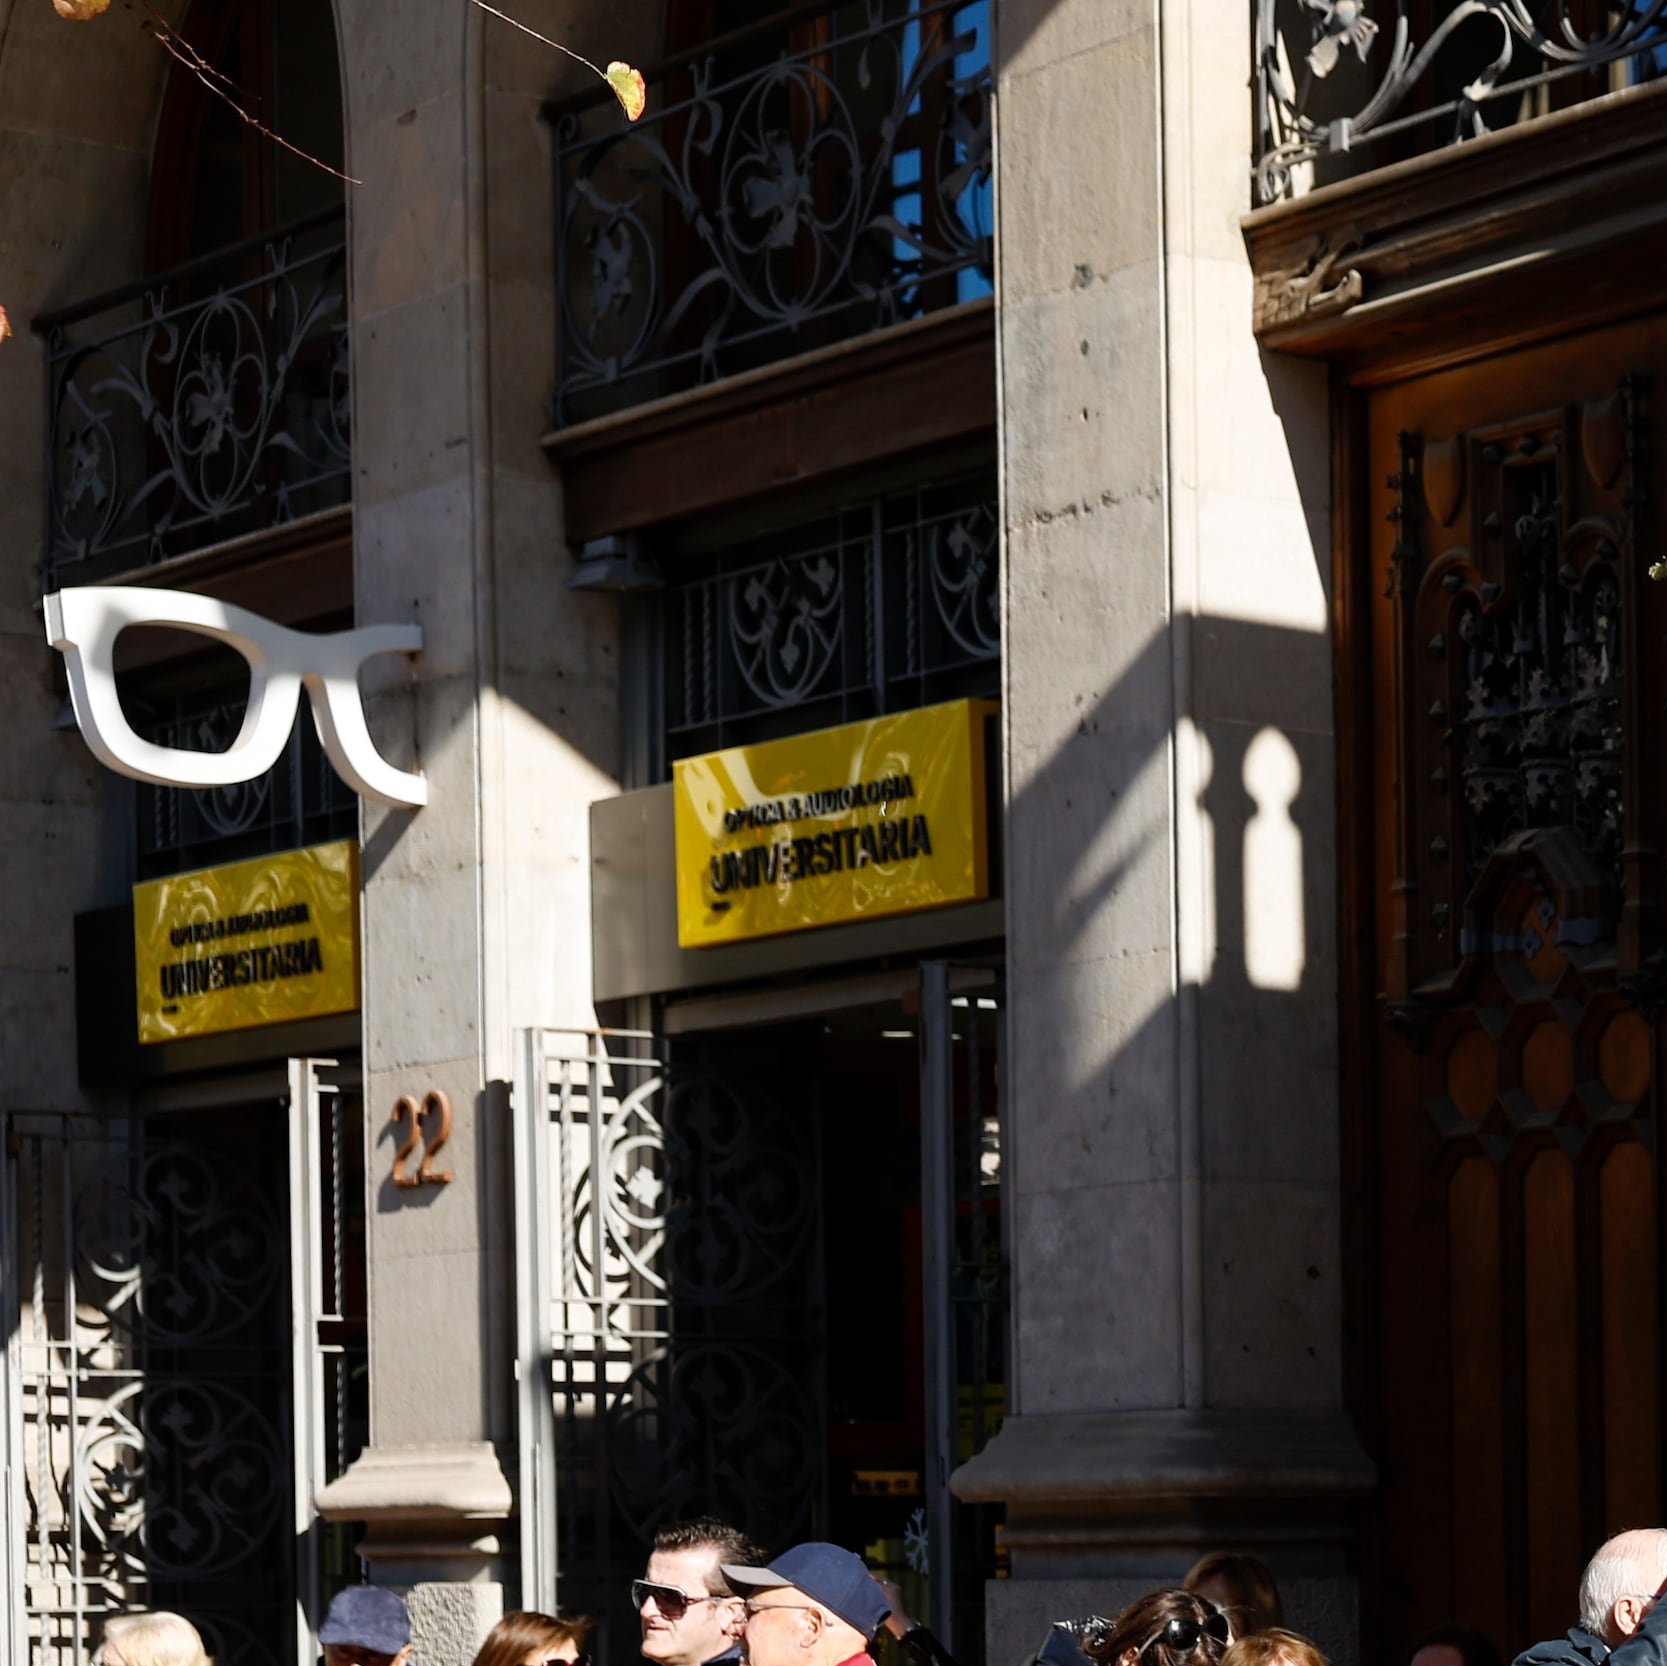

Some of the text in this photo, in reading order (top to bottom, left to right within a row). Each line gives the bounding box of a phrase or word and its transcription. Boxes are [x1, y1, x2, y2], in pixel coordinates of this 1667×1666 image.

[710, 814, 932, 894] UNIVERSITARIA
[160, 936, 324, 1000] UNIVERSITARIA
[391, 1089, 453, 1189] 22
